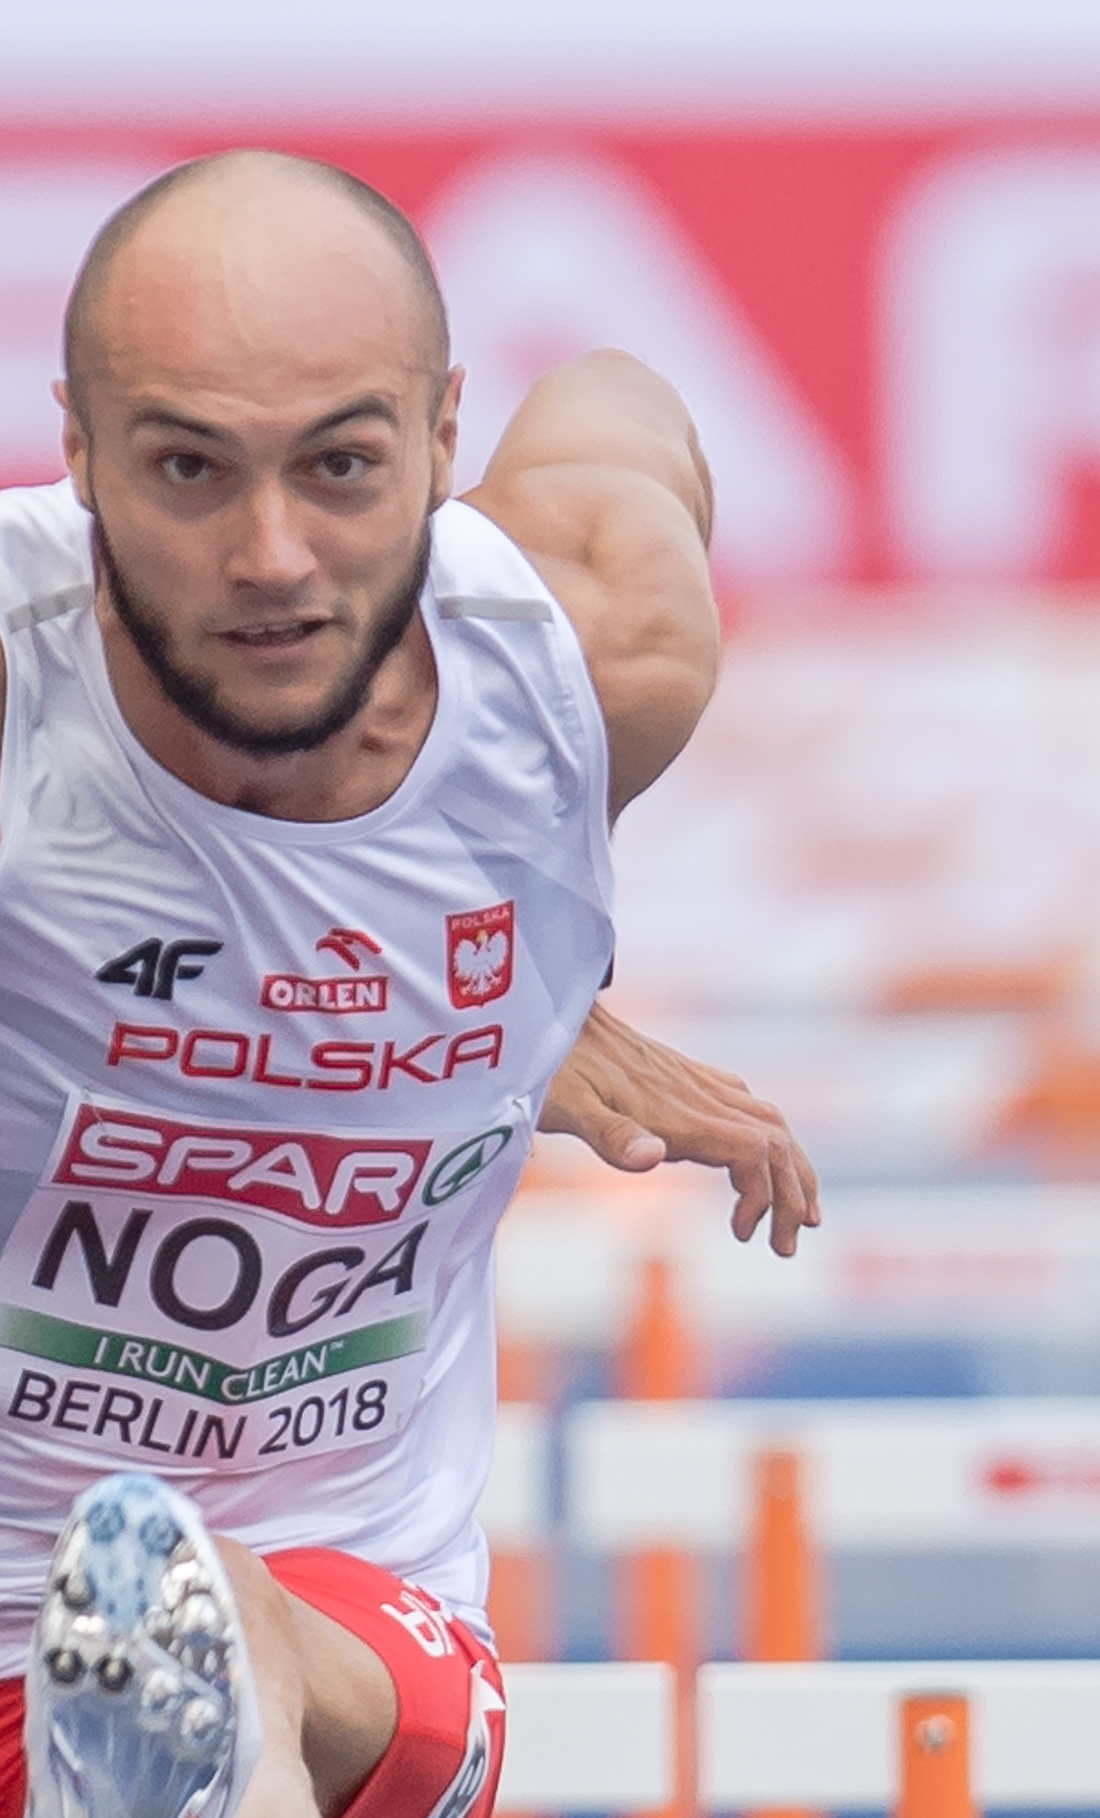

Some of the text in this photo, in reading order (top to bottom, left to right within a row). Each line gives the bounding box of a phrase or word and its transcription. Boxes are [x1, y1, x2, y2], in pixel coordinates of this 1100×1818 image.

[95, 936, 224, 1000] 4F
[267, 976, 380, 1008] ORLEN
[106, 1021, 503, 1092] POLSKA
[70, 1121, 417, 1215] SPAR
[31, 1200, 430, 1337] NOGA
[93, 1336, 108, 1365] I
[117, 1340, 212, 1392] RUN
[7, 1368, 388, 1460] BERLIN 2018
